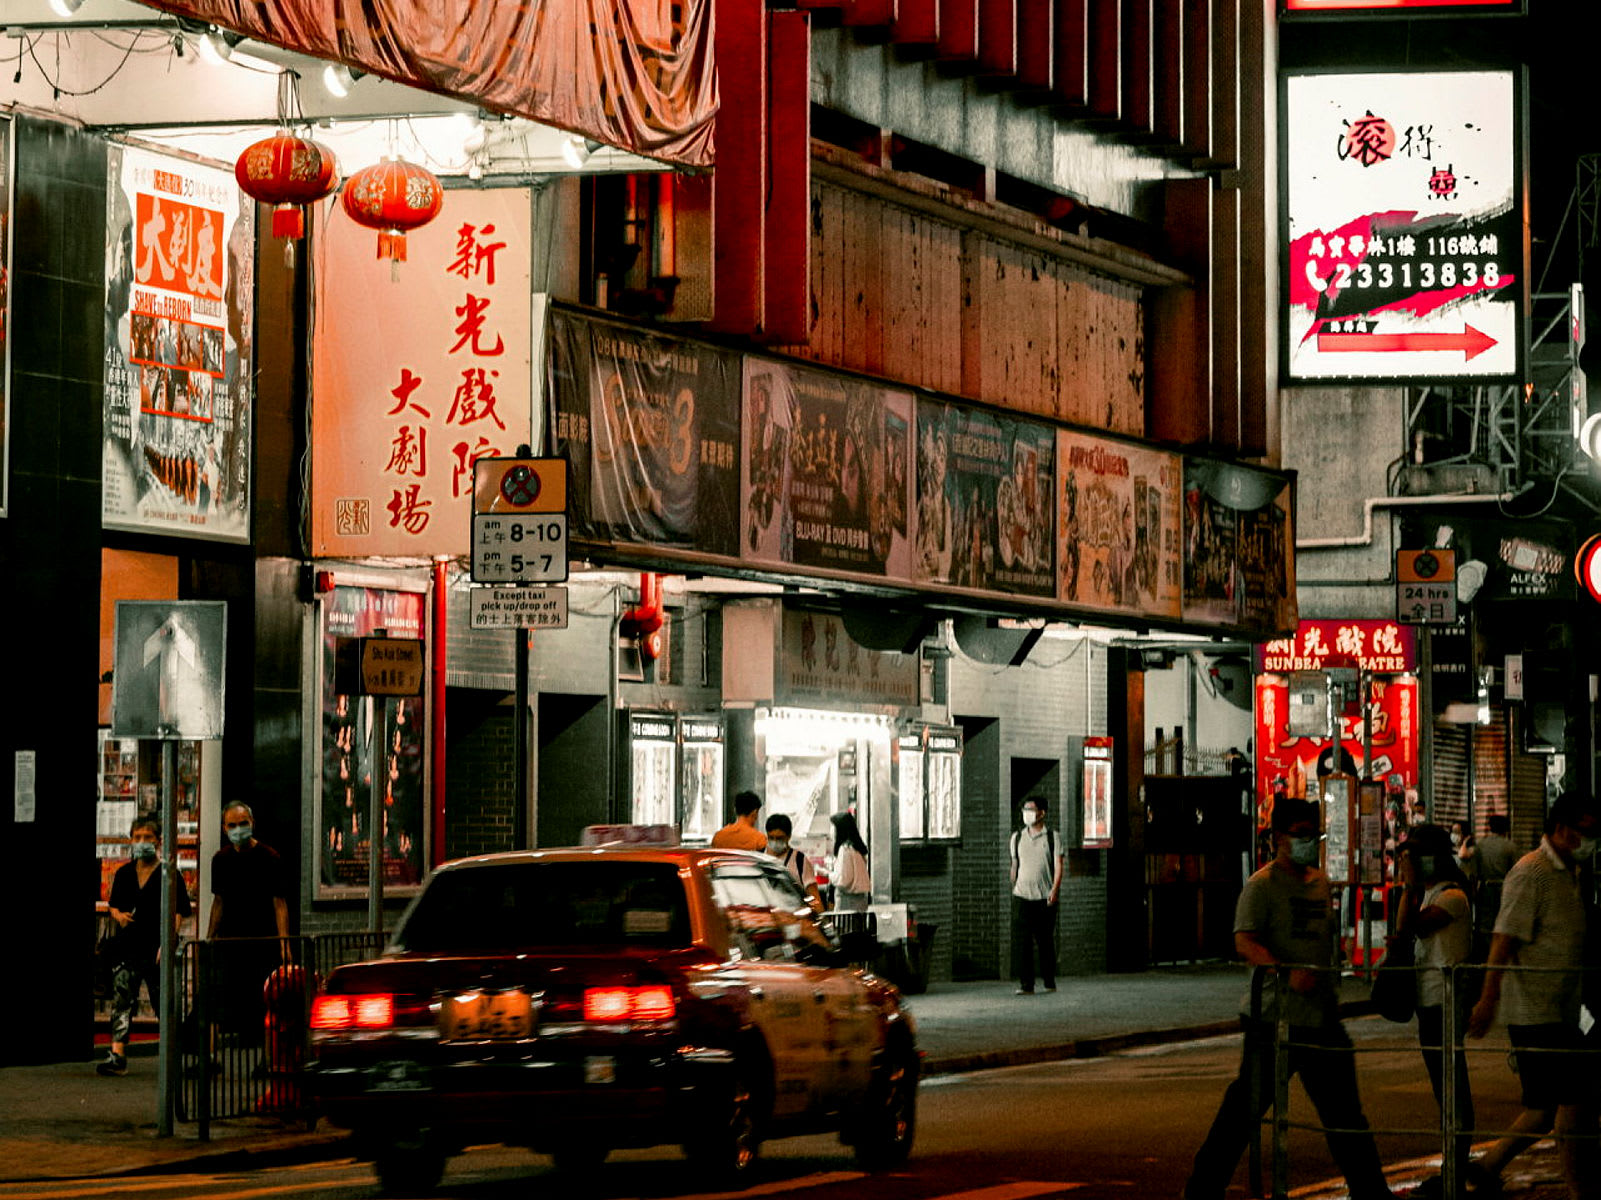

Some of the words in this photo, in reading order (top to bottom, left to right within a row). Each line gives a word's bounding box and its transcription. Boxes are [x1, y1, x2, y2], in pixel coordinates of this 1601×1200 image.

[1335, 262, 1500, 289] 23313838
[135, 290, 157, 315] SHAVE
[164, 296, 192, 321] REBORN
[383, 368, 433, 537] 大劇場
[484, 520, 501, 530] am
[510, 522, 561, 542] 8-10
[479, 531, 506, 545] 上午
[484, 553, 501, 561] pm
[479, 562, 506, 576] 下午
[493, 590, 526, 602] Except
[528, 591, 546, 600] taxi
[1405, 587, 1423, 599] 24
[1428, 587, 1449, 598] hrs
[481, 601, 501, 611] pick
[503, 601, 541, 612] up/drop
[543, 601, 557, 610] off
[476, 613, 561, 626] 的士上落客除外
[1265, 656, 1325, 670] SUNBEA
[1358, 656, 1405, 670] EATRE
